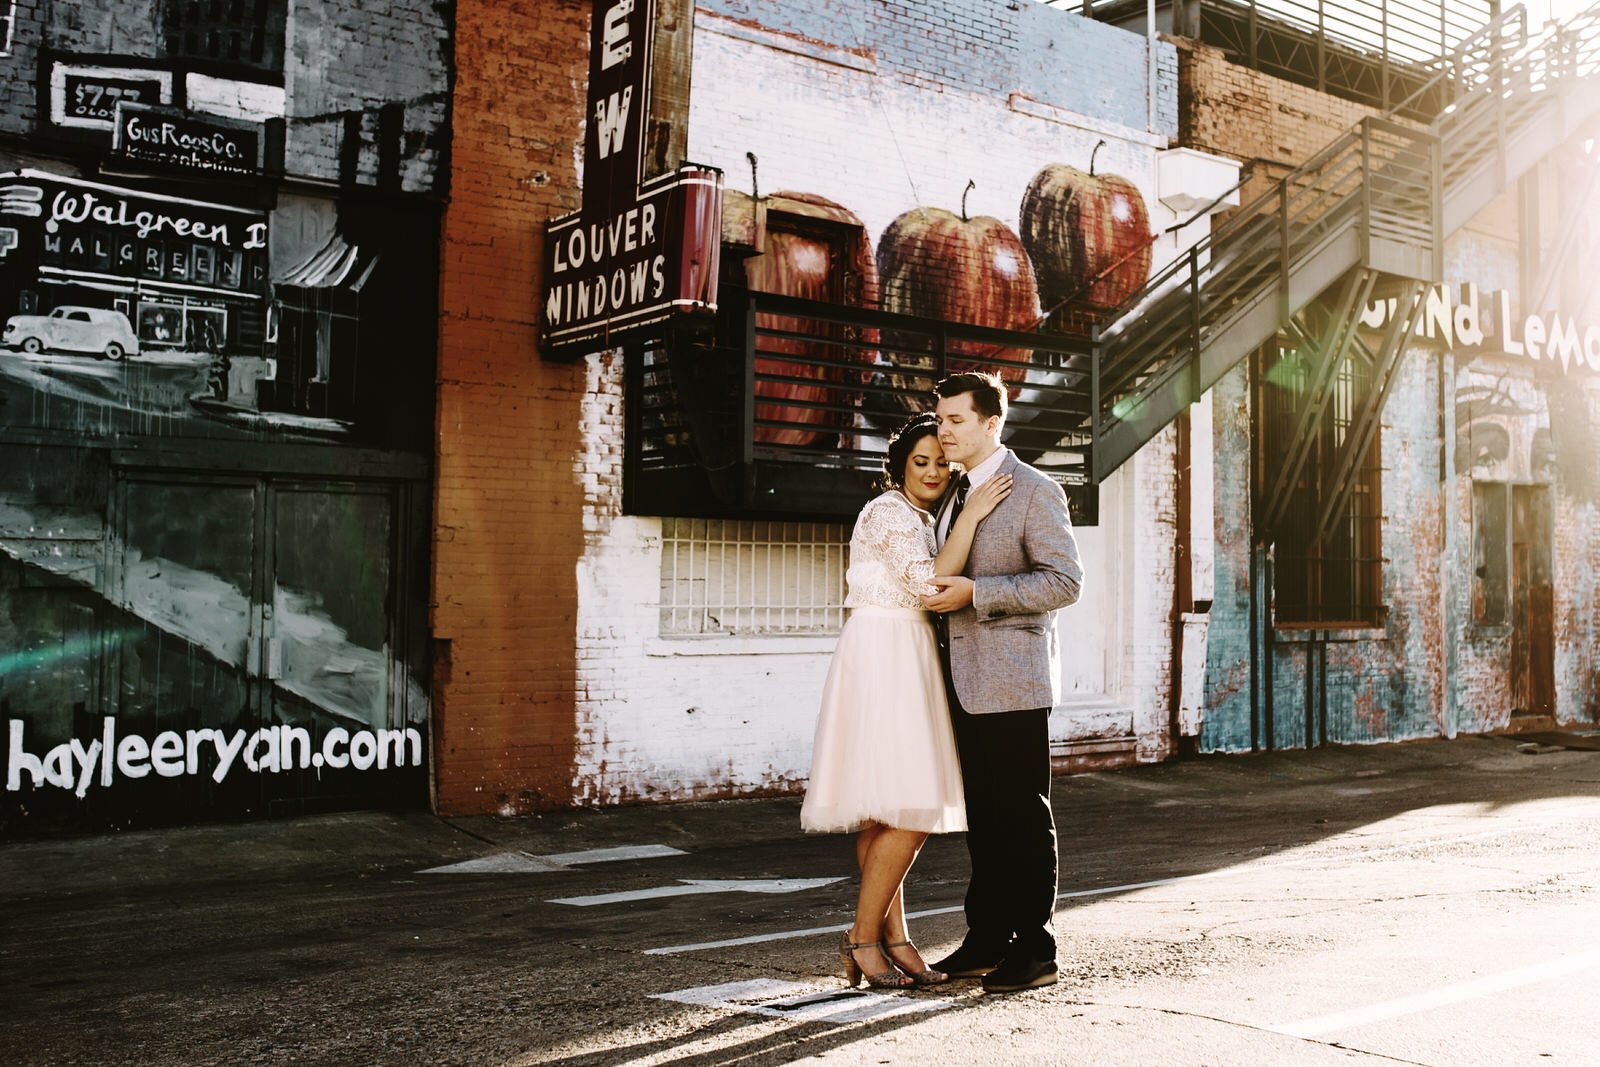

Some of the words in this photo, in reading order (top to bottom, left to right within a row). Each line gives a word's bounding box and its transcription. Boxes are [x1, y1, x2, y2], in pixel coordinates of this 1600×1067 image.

[45, 190, 230, 246] Walgreen
[553, 203, 656, 273] LOUVER
[546, 254, 665, 327] WINDOWS
[6, 716, 422, 799] hayleeryan.com
